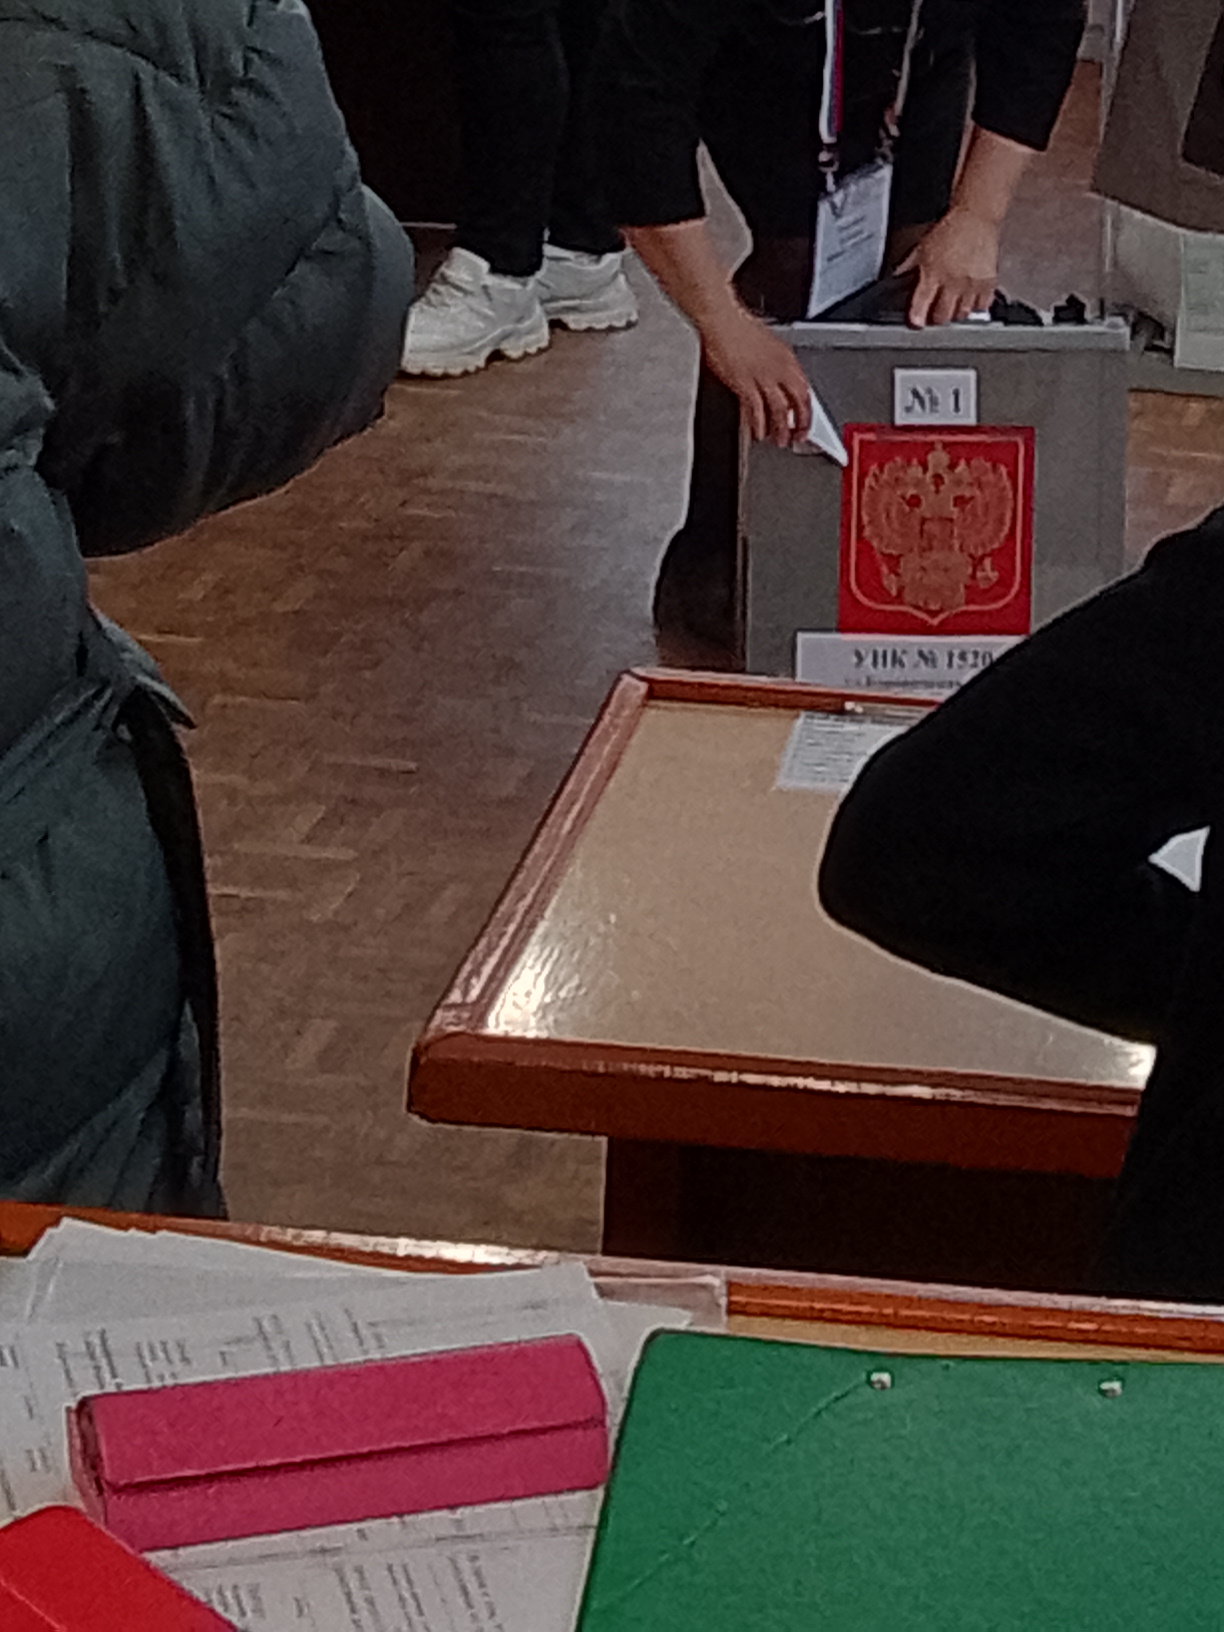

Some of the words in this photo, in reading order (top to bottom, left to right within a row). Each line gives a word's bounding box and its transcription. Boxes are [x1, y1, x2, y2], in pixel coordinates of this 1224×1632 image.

[905, 387, 938, 414] №
[951, 388, 961, 412] 1
[914, 649, 942, 669] №
